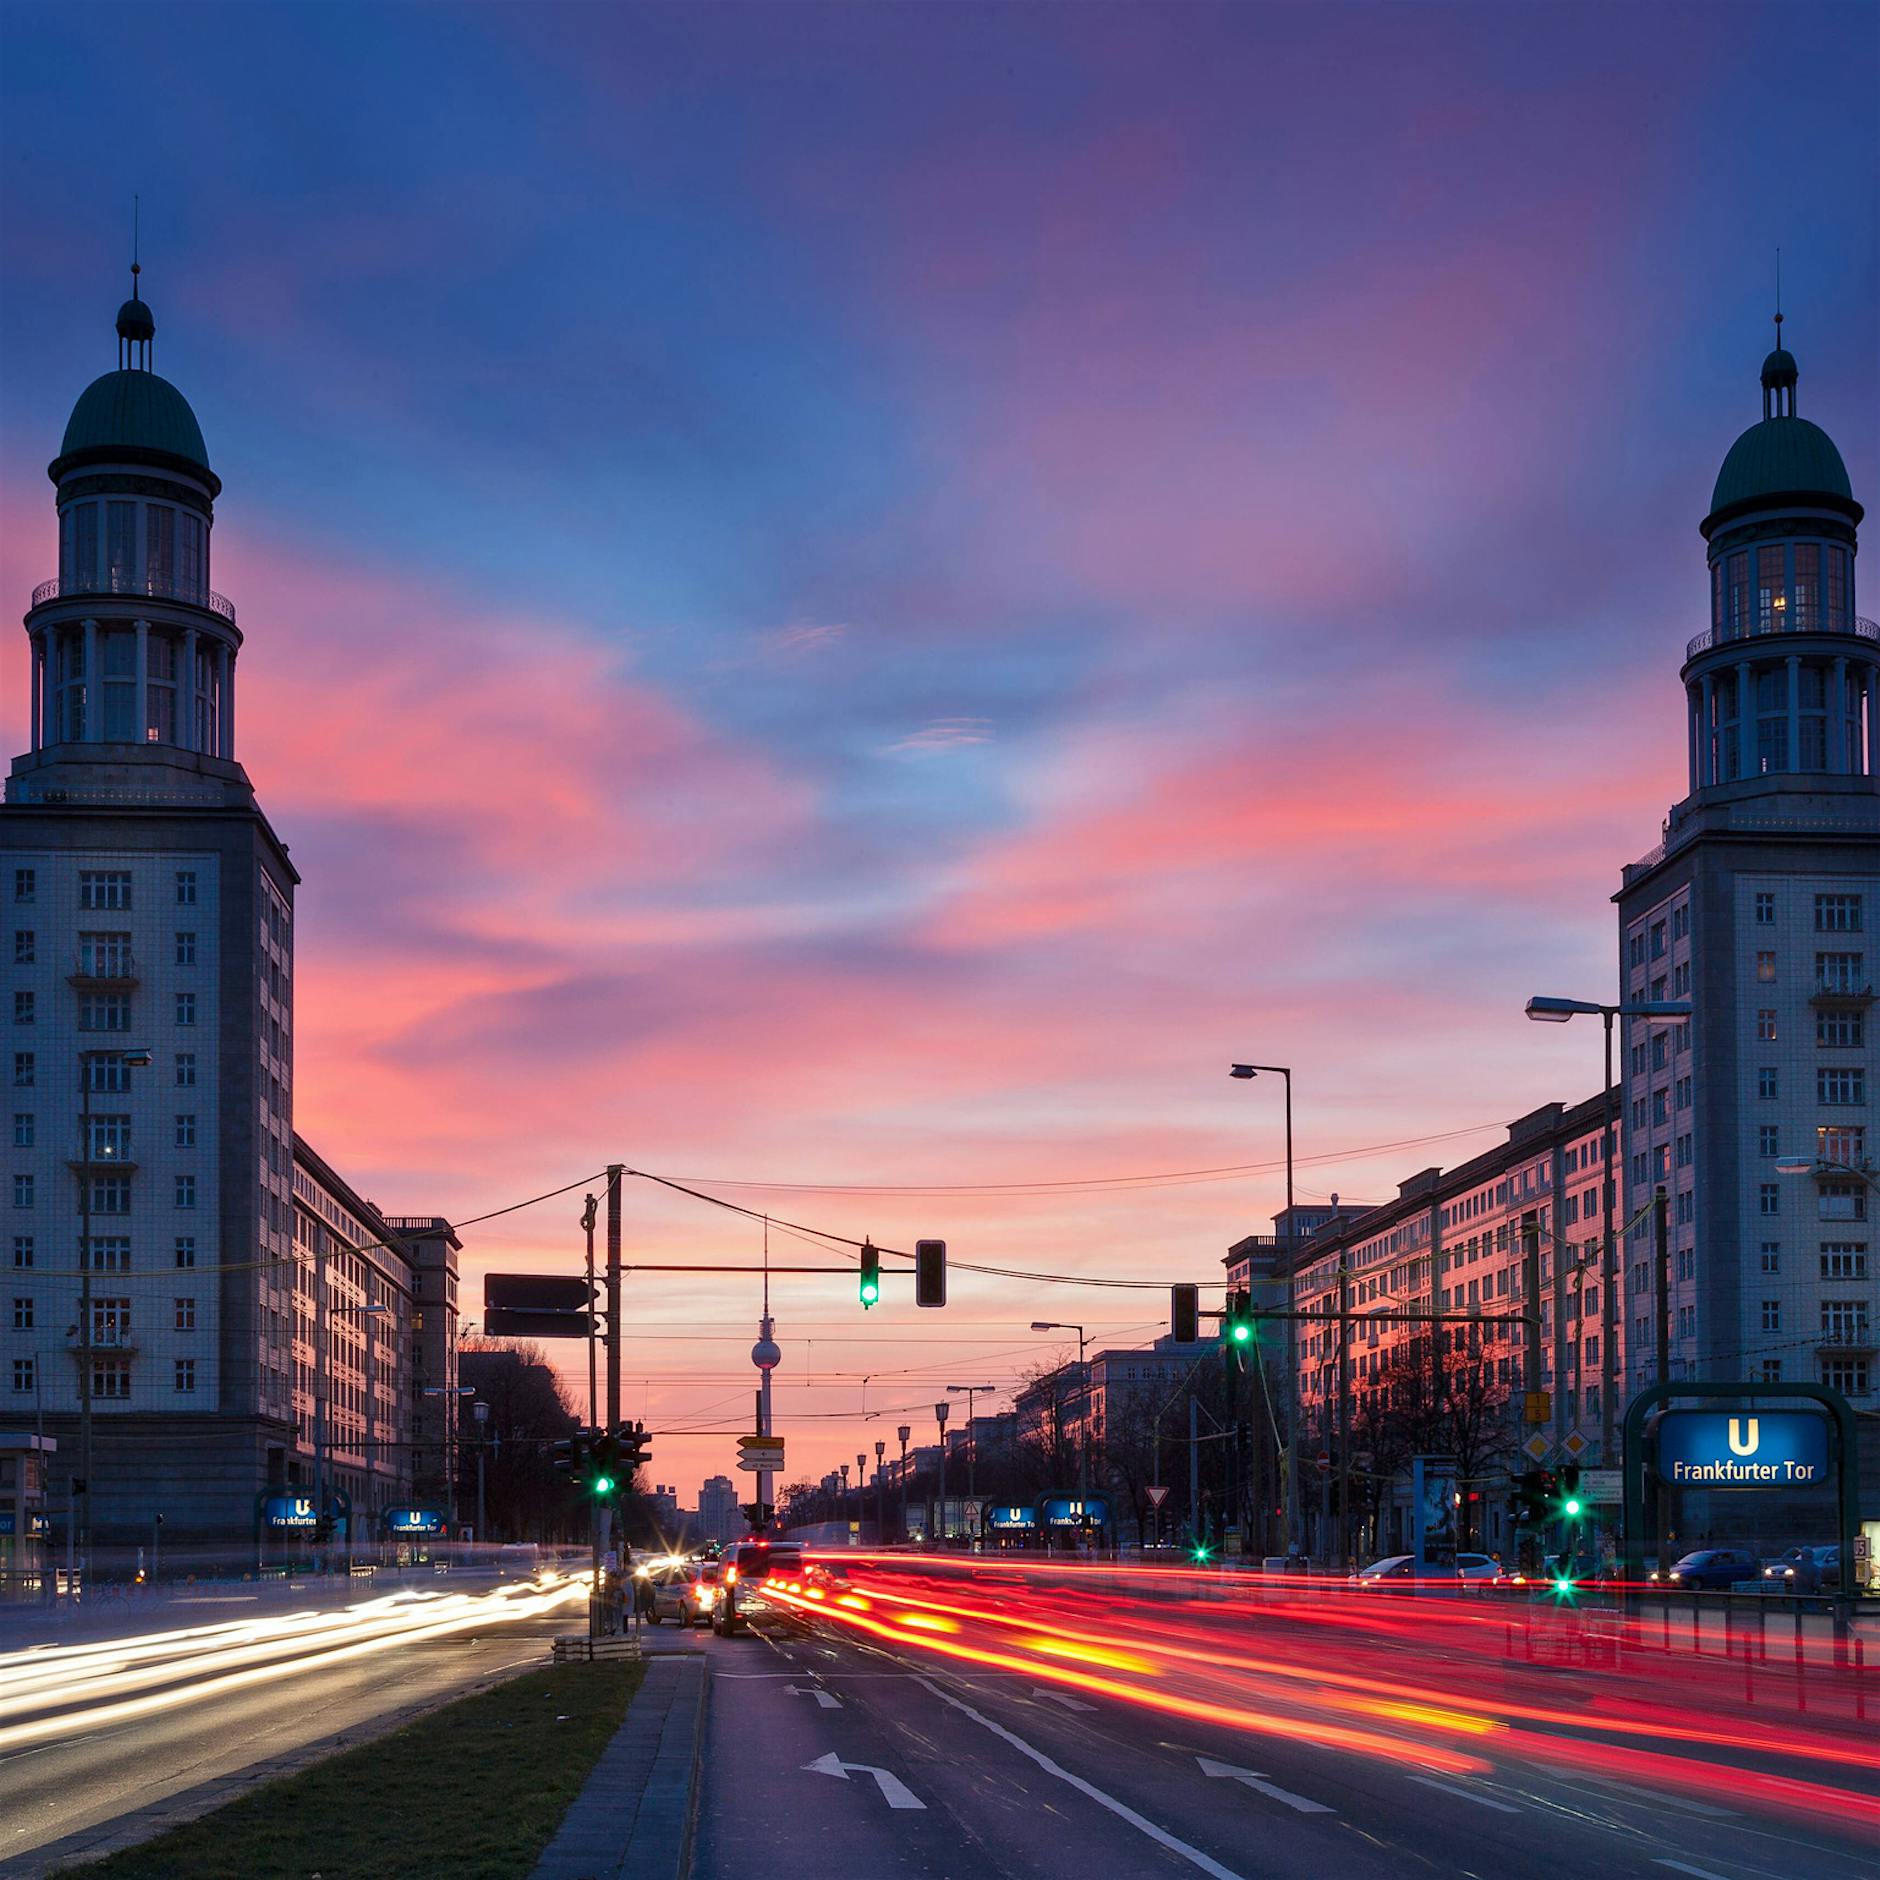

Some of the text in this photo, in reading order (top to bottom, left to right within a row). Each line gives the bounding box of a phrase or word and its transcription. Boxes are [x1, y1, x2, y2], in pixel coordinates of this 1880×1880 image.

[1728, 1418, 1760, 1457] U
[1673, 1459, 1815, 1480] Frankfurter Tor
[295, 1499, 310, 1516] U
[1010, 1508, 1021, 1522] U
[0, 1519, 12, 1530] or
[410, 1511, 421, 1524] U
